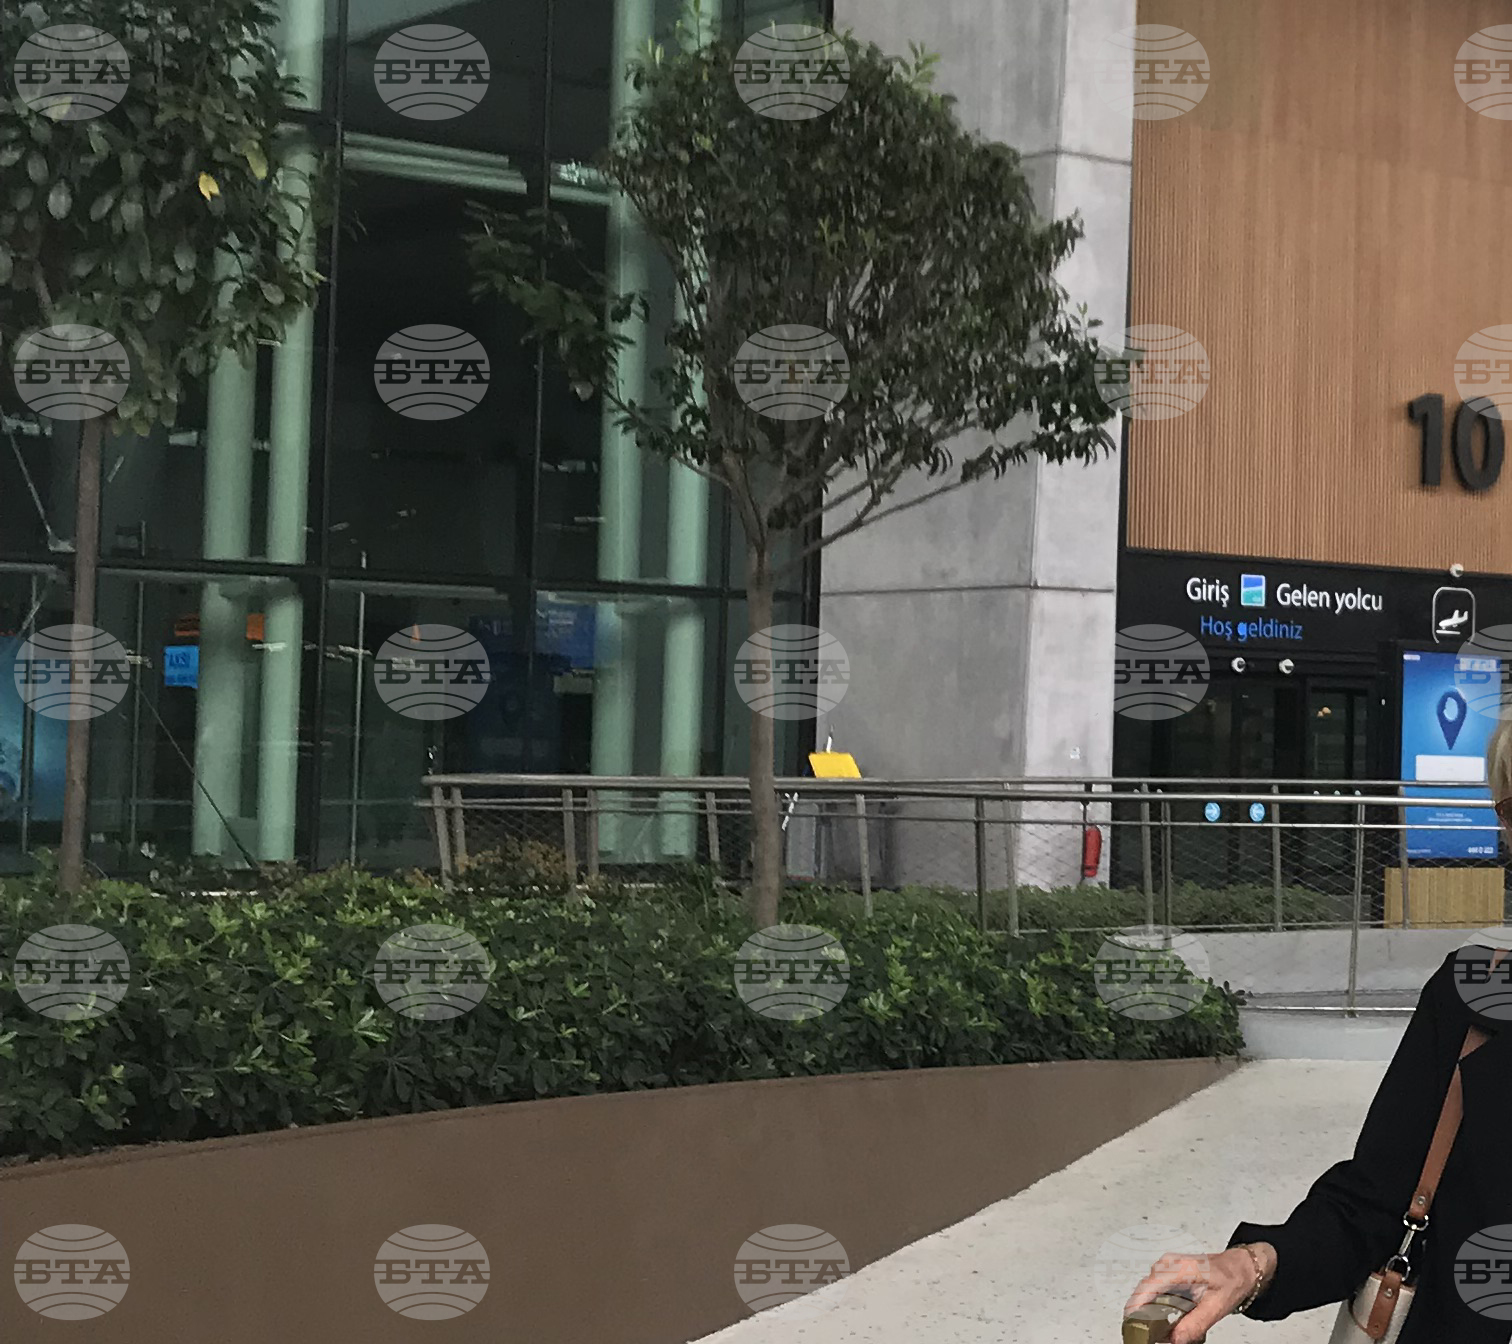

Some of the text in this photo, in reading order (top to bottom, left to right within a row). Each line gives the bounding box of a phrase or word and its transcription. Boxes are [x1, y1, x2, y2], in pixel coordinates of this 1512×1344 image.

[1407, 393, 1505, 492] 10
[1186, 577, 1383, 615] Giriş Gelen yolcu
[1200, 615, 1303, 642] Hoş geldiniz
